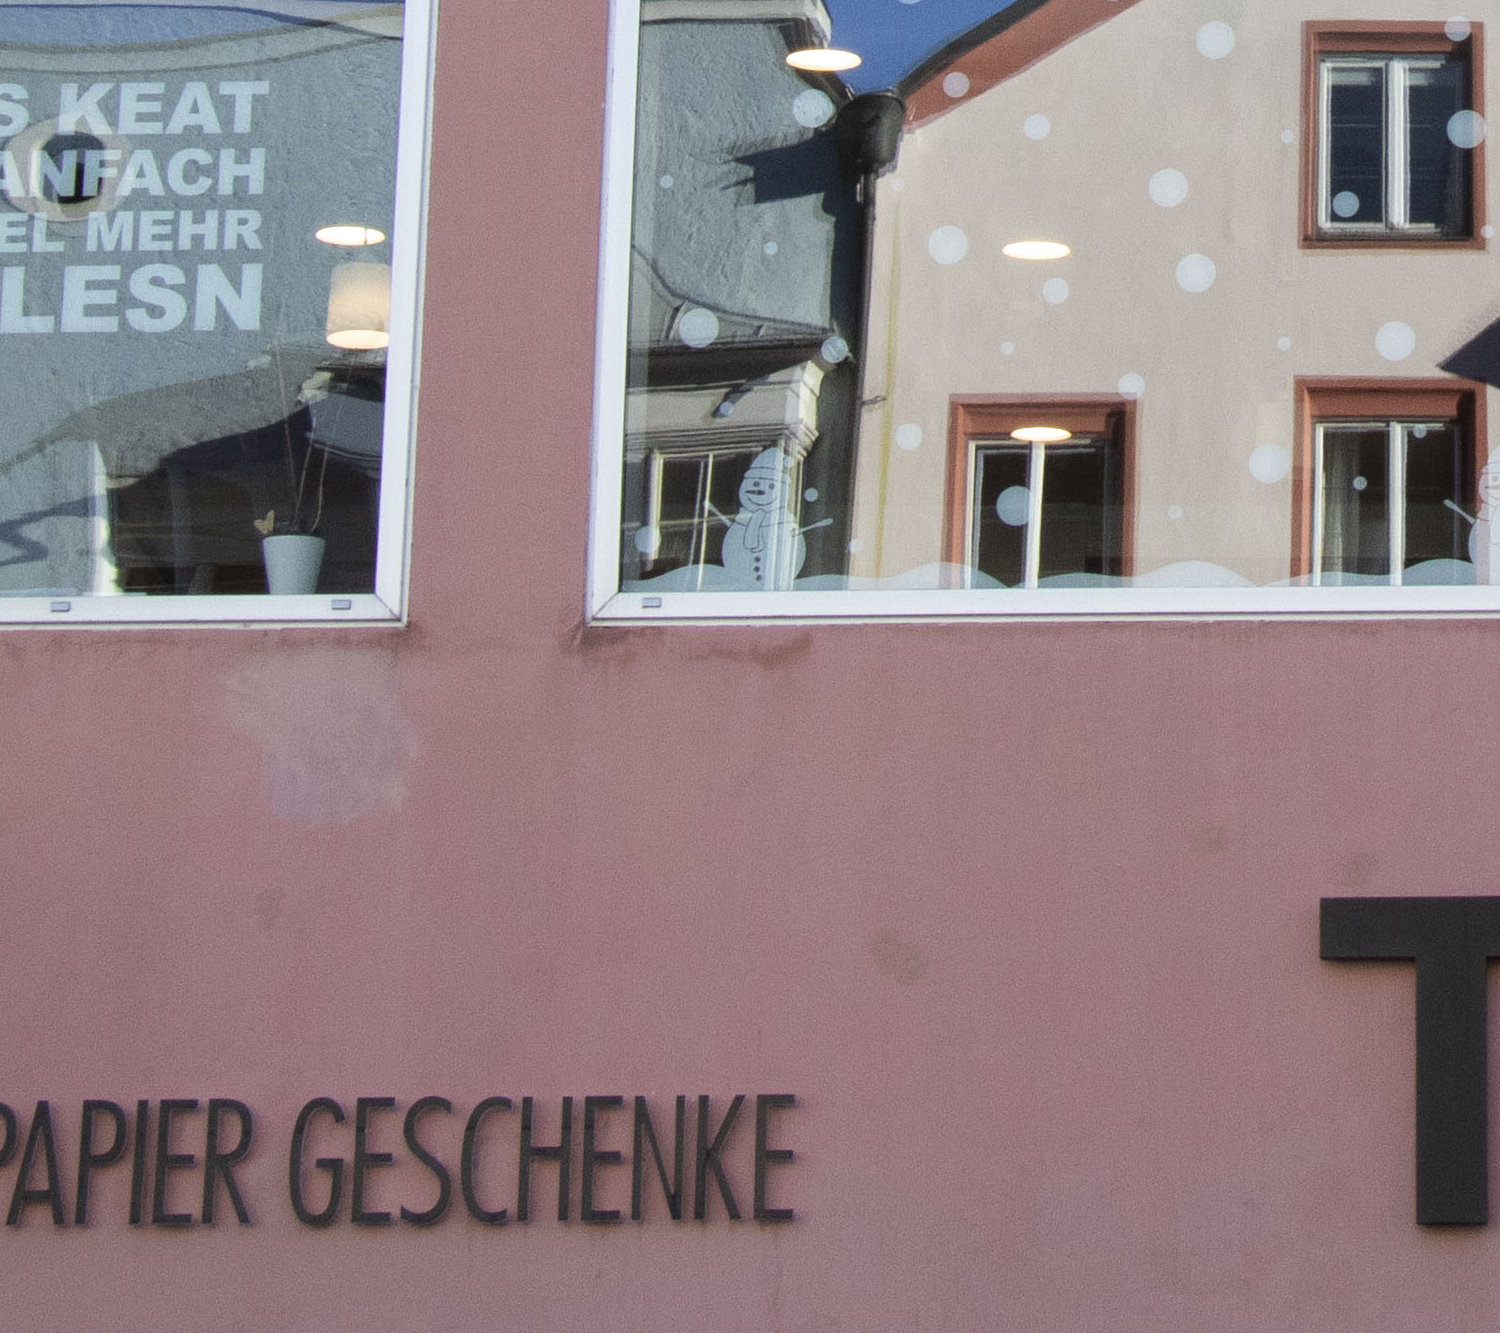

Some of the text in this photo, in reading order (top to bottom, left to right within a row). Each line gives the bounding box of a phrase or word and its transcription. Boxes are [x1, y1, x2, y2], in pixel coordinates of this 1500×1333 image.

[58, 80, 270, 134] KEAT
[86, 209, 263, 252] MEHR
[288, 1094, 797, 1230] GESCHENKE
